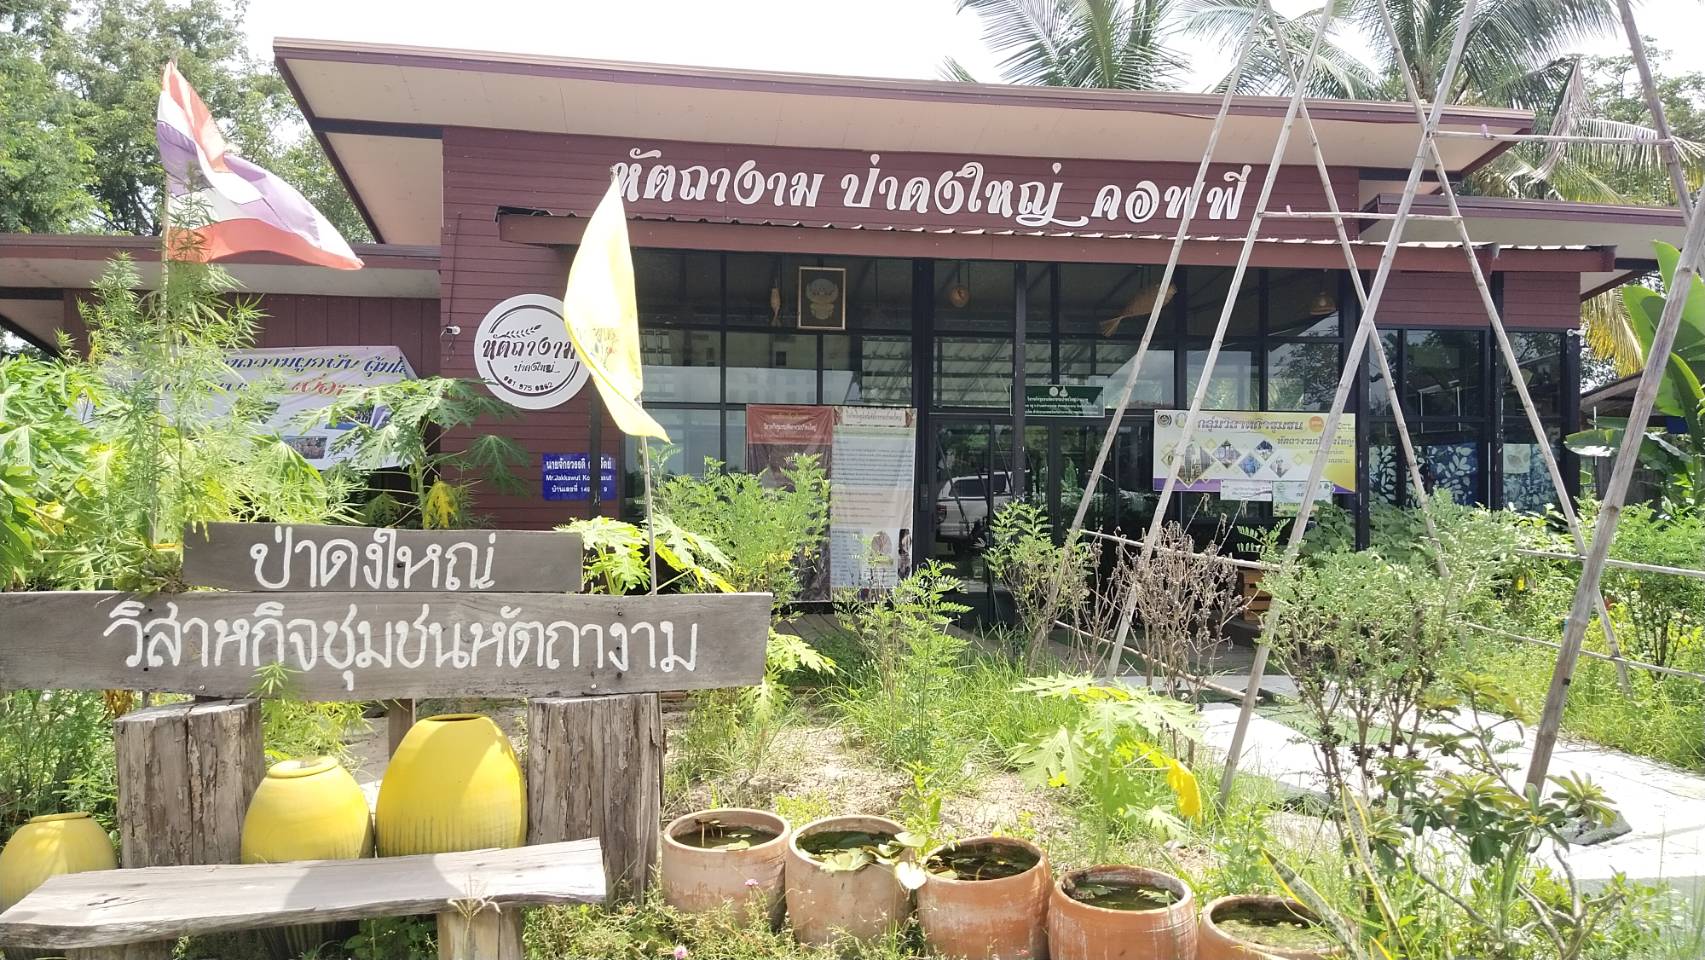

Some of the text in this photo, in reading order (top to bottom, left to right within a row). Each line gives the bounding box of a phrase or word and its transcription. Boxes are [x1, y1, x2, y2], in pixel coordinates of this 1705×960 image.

[612, 147, 825, 208] หัตถางาม
[840, 153, 1089, 227] ป่าดงใหญ่
[103, 600, 698, 691] วิสาหกิจชุมชนหัตถางาม
